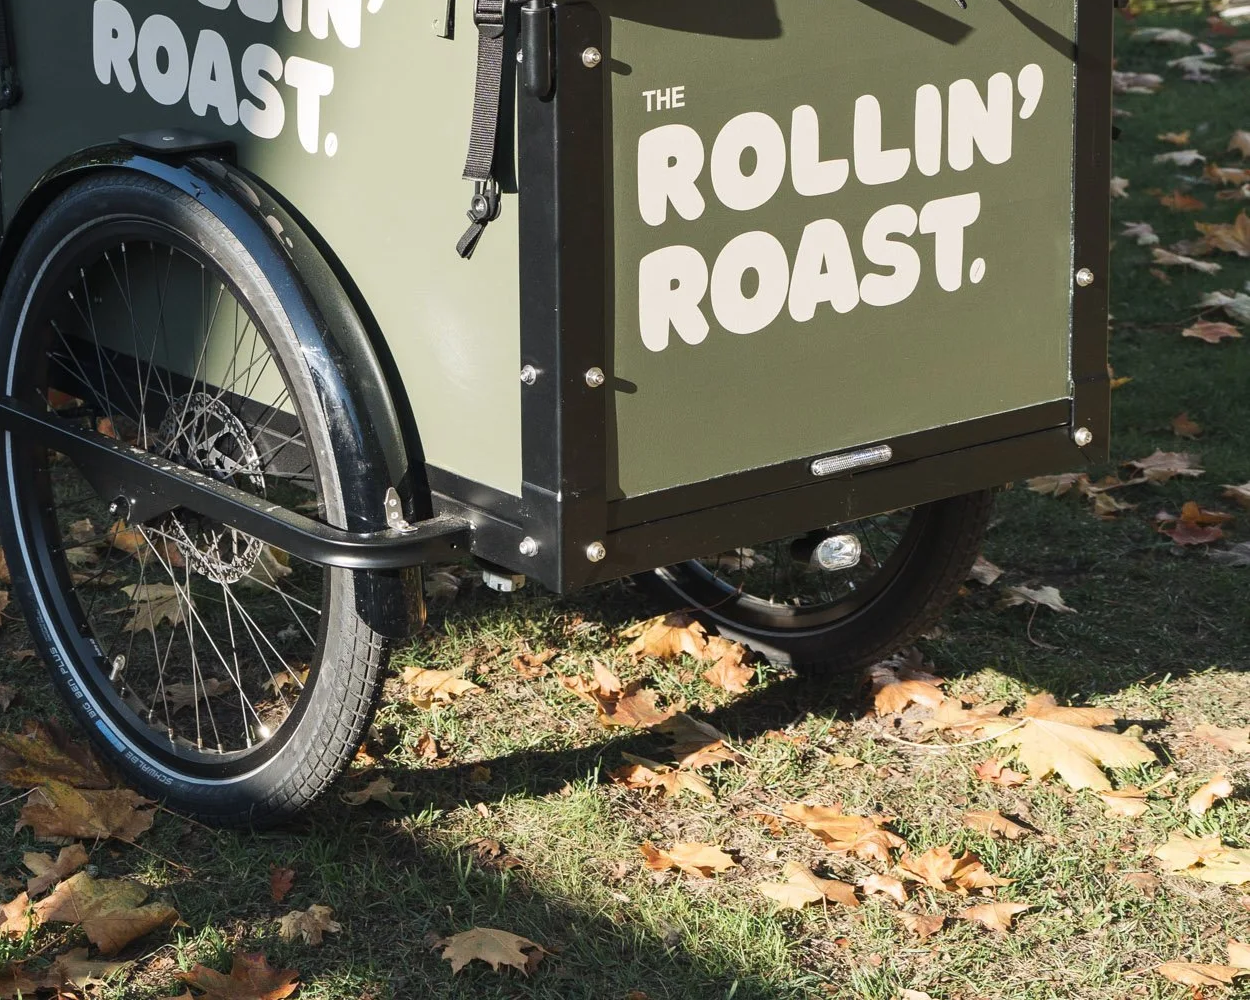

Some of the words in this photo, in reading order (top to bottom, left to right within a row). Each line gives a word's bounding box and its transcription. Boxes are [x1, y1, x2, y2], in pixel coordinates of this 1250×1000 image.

[642, 85, 686, 112] THE
[638, 63, 1044, 226] ROLLIN'
[638, 191, 986, 352] ROAST.
[49, 646, 69, 675] PLUS
[67, 679, 84, 699] BEN
[82, 702, 97, 719] BIG
[125, 751, 174, 785] SCHWALBE
